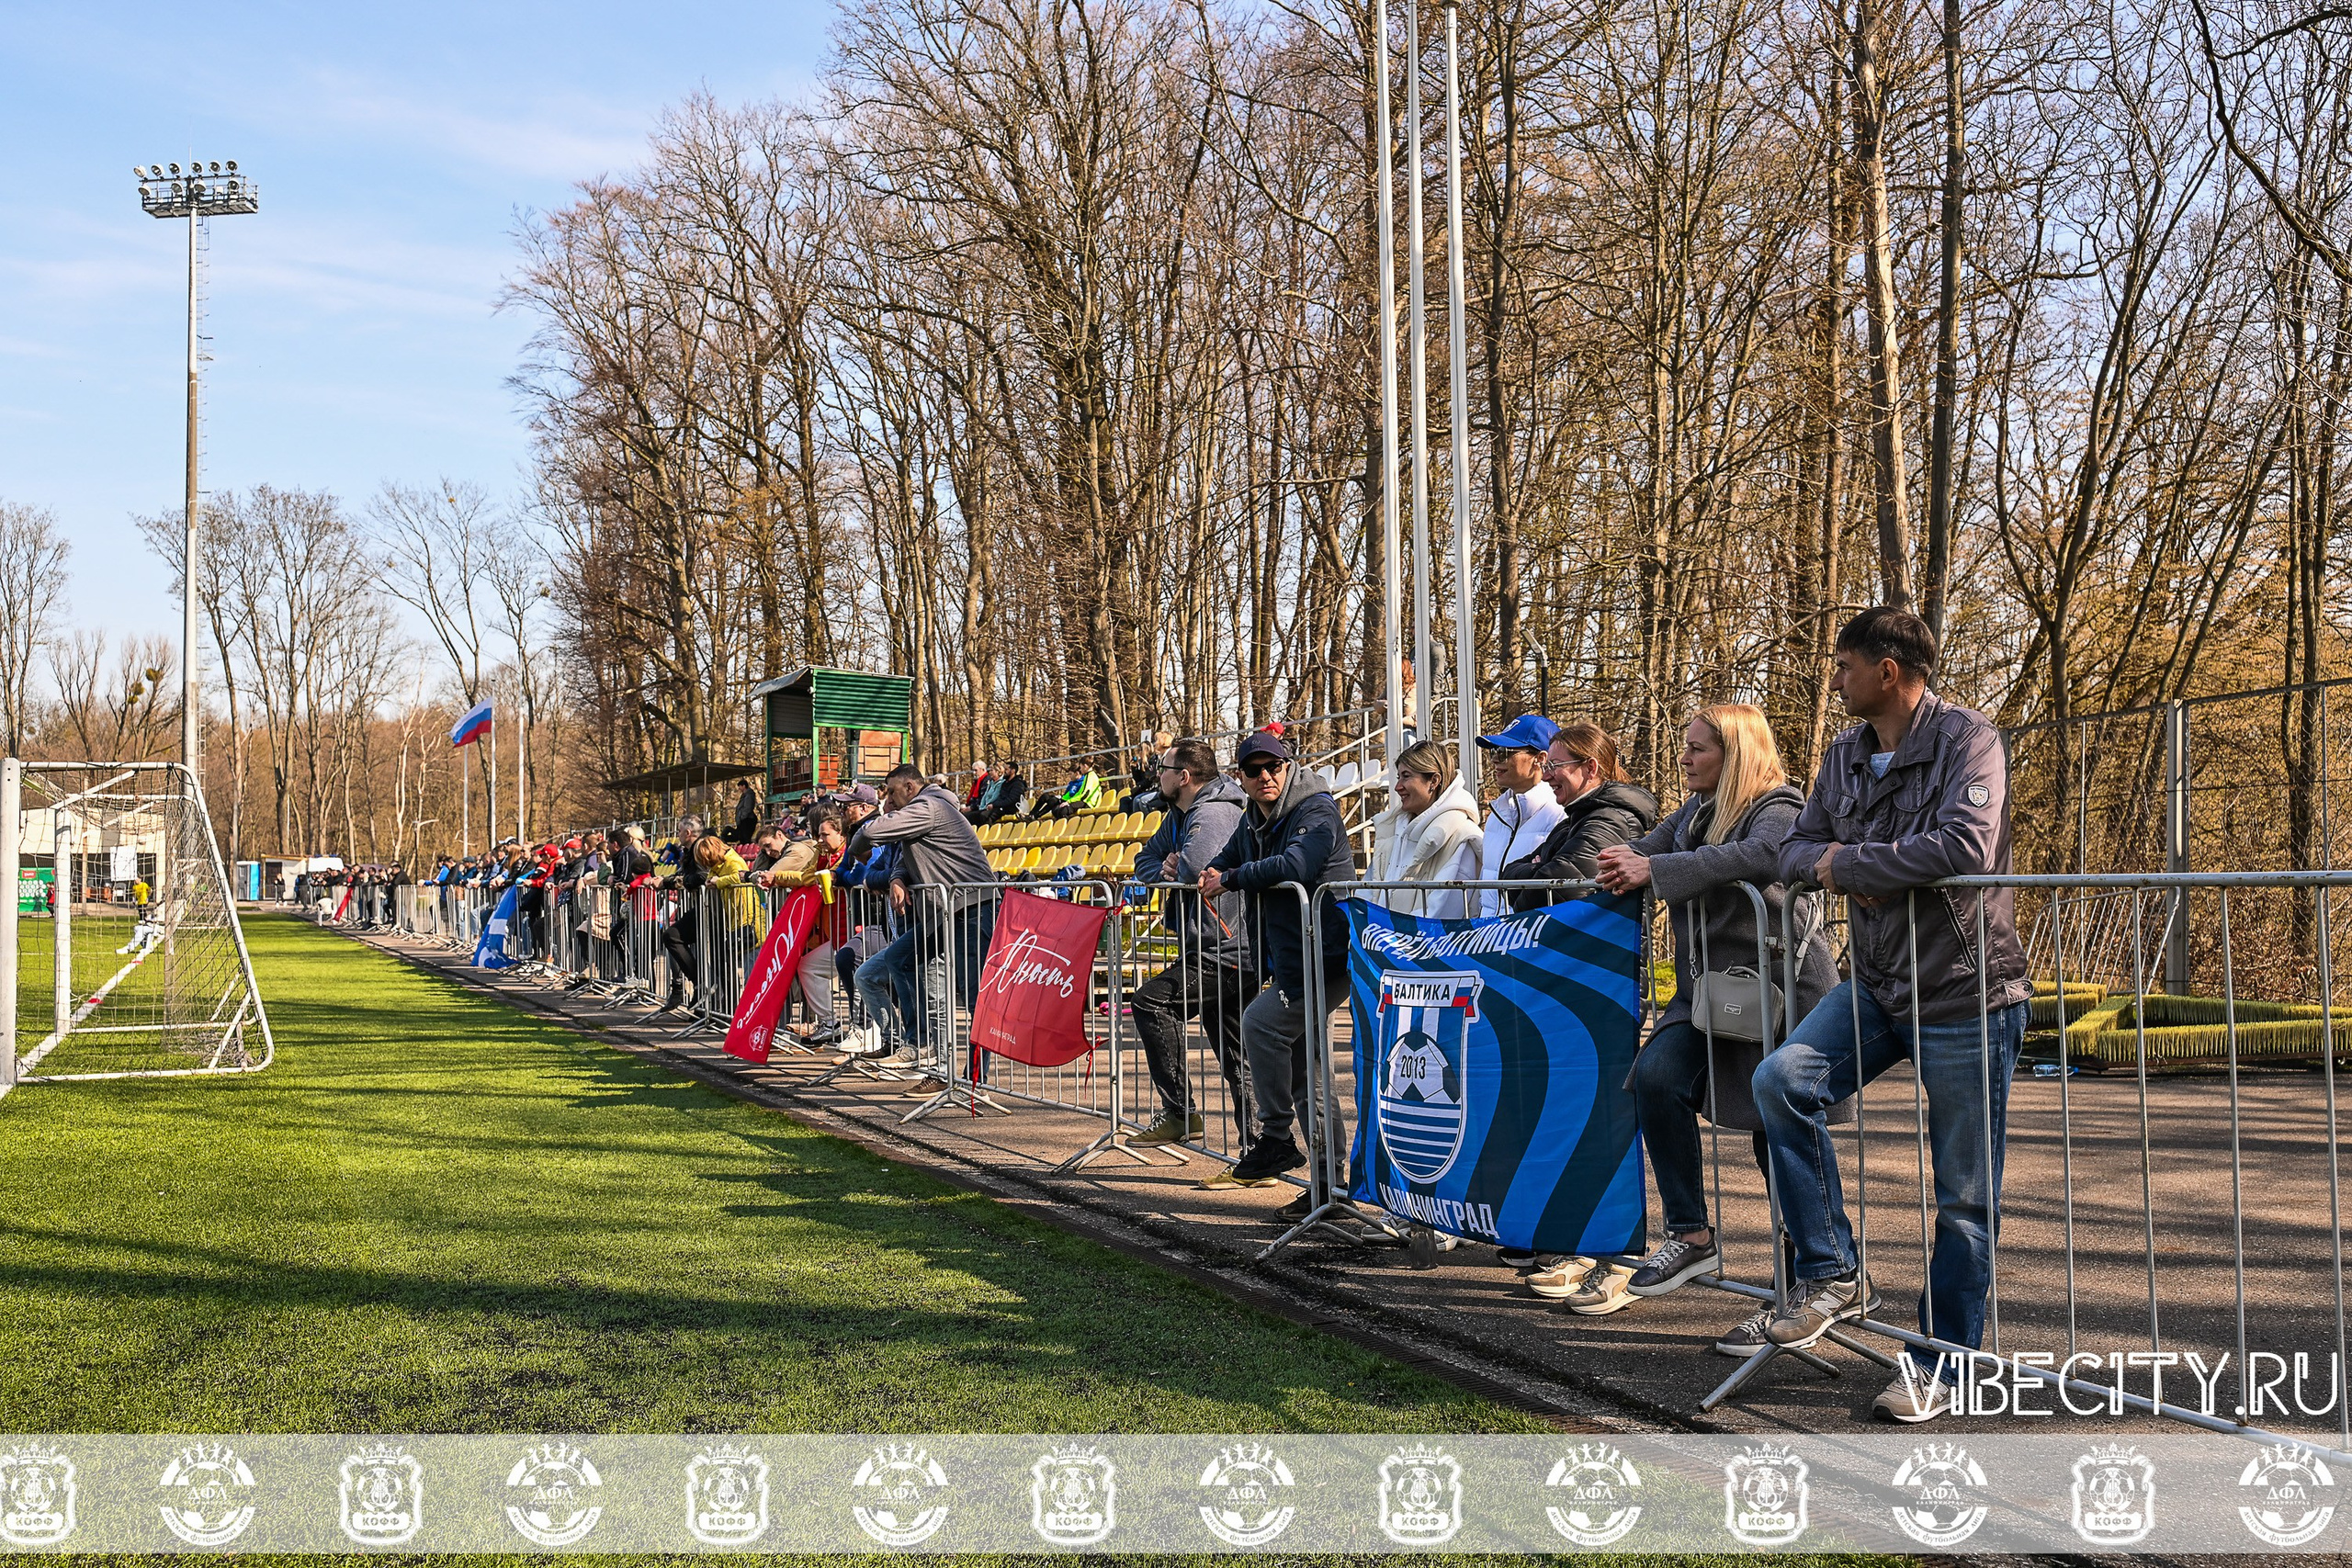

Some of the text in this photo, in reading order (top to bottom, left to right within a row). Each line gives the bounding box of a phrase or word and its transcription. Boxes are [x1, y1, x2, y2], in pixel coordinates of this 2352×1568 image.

[979, 928, 1074, 998] Юность
[1394, 983, 1450, 1000] БАЛТИКА
[1400, 1055, 1427, 1079] 2013
[1379, 1182, 1500, 1239] КАЛИНИНГРАД
